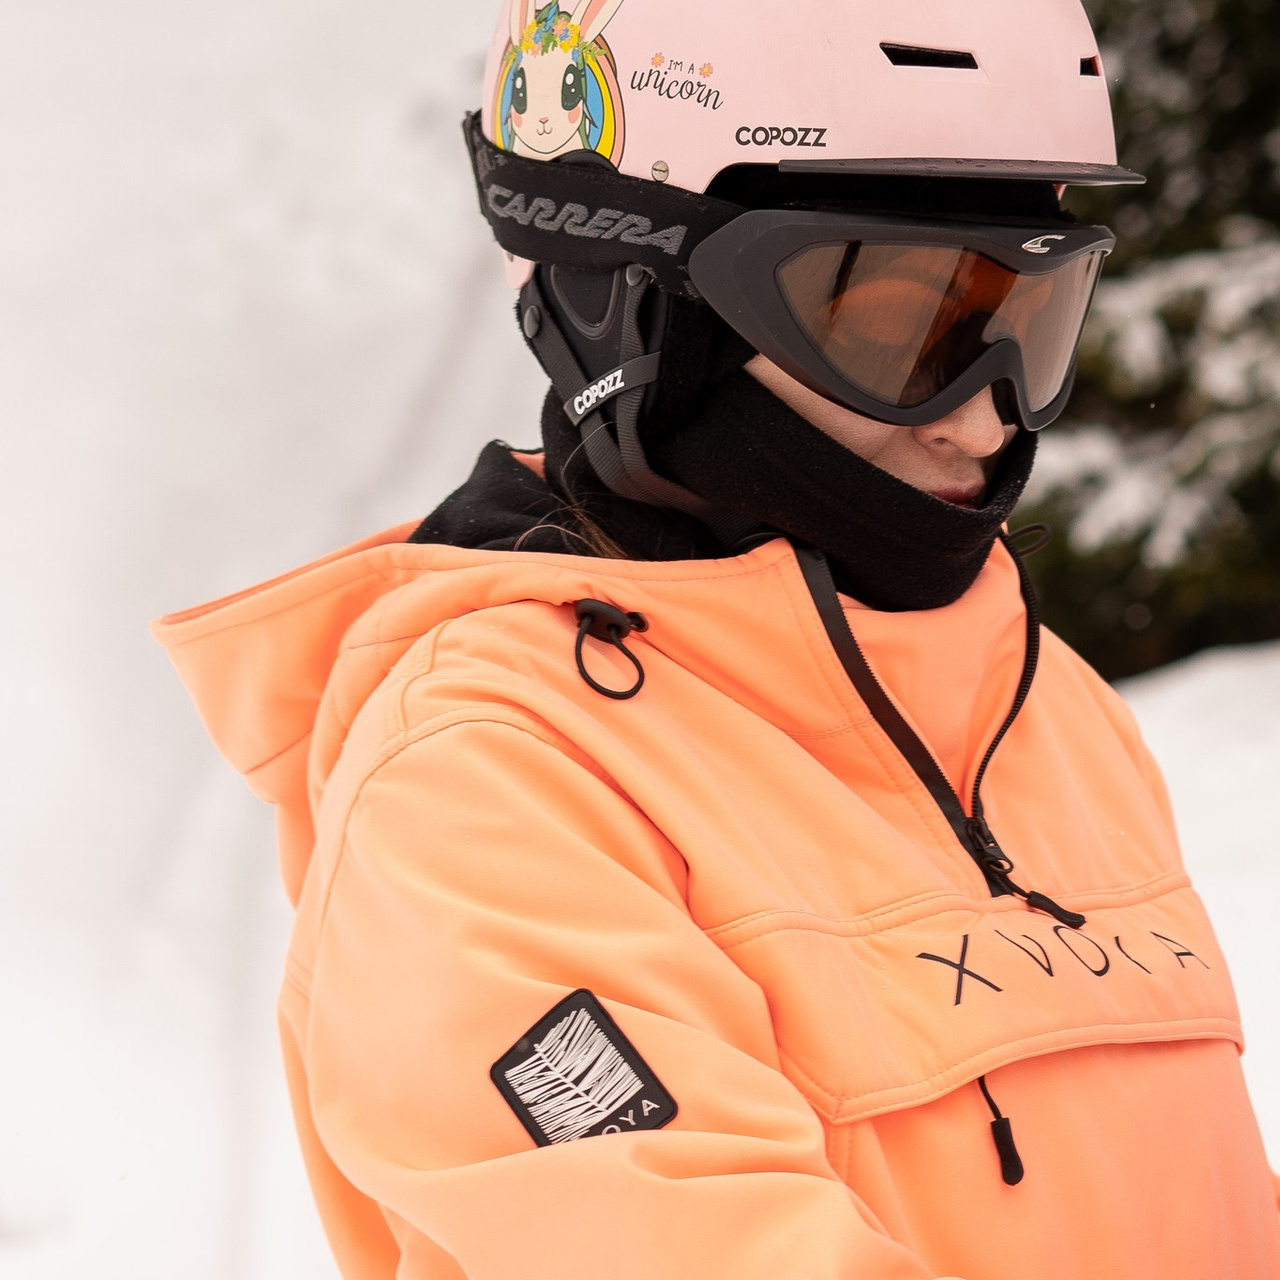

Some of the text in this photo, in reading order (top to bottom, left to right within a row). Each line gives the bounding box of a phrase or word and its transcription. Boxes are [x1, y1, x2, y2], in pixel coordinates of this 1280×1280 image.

[667, 59, 695, 75] I'M A
[630, 68, 724, 110] unicorn
[735, 126, 828, 147] COPOZZ
[488, 183, 688, 256] CARRERA
[573, 368, 625, 415] COPOZZ
